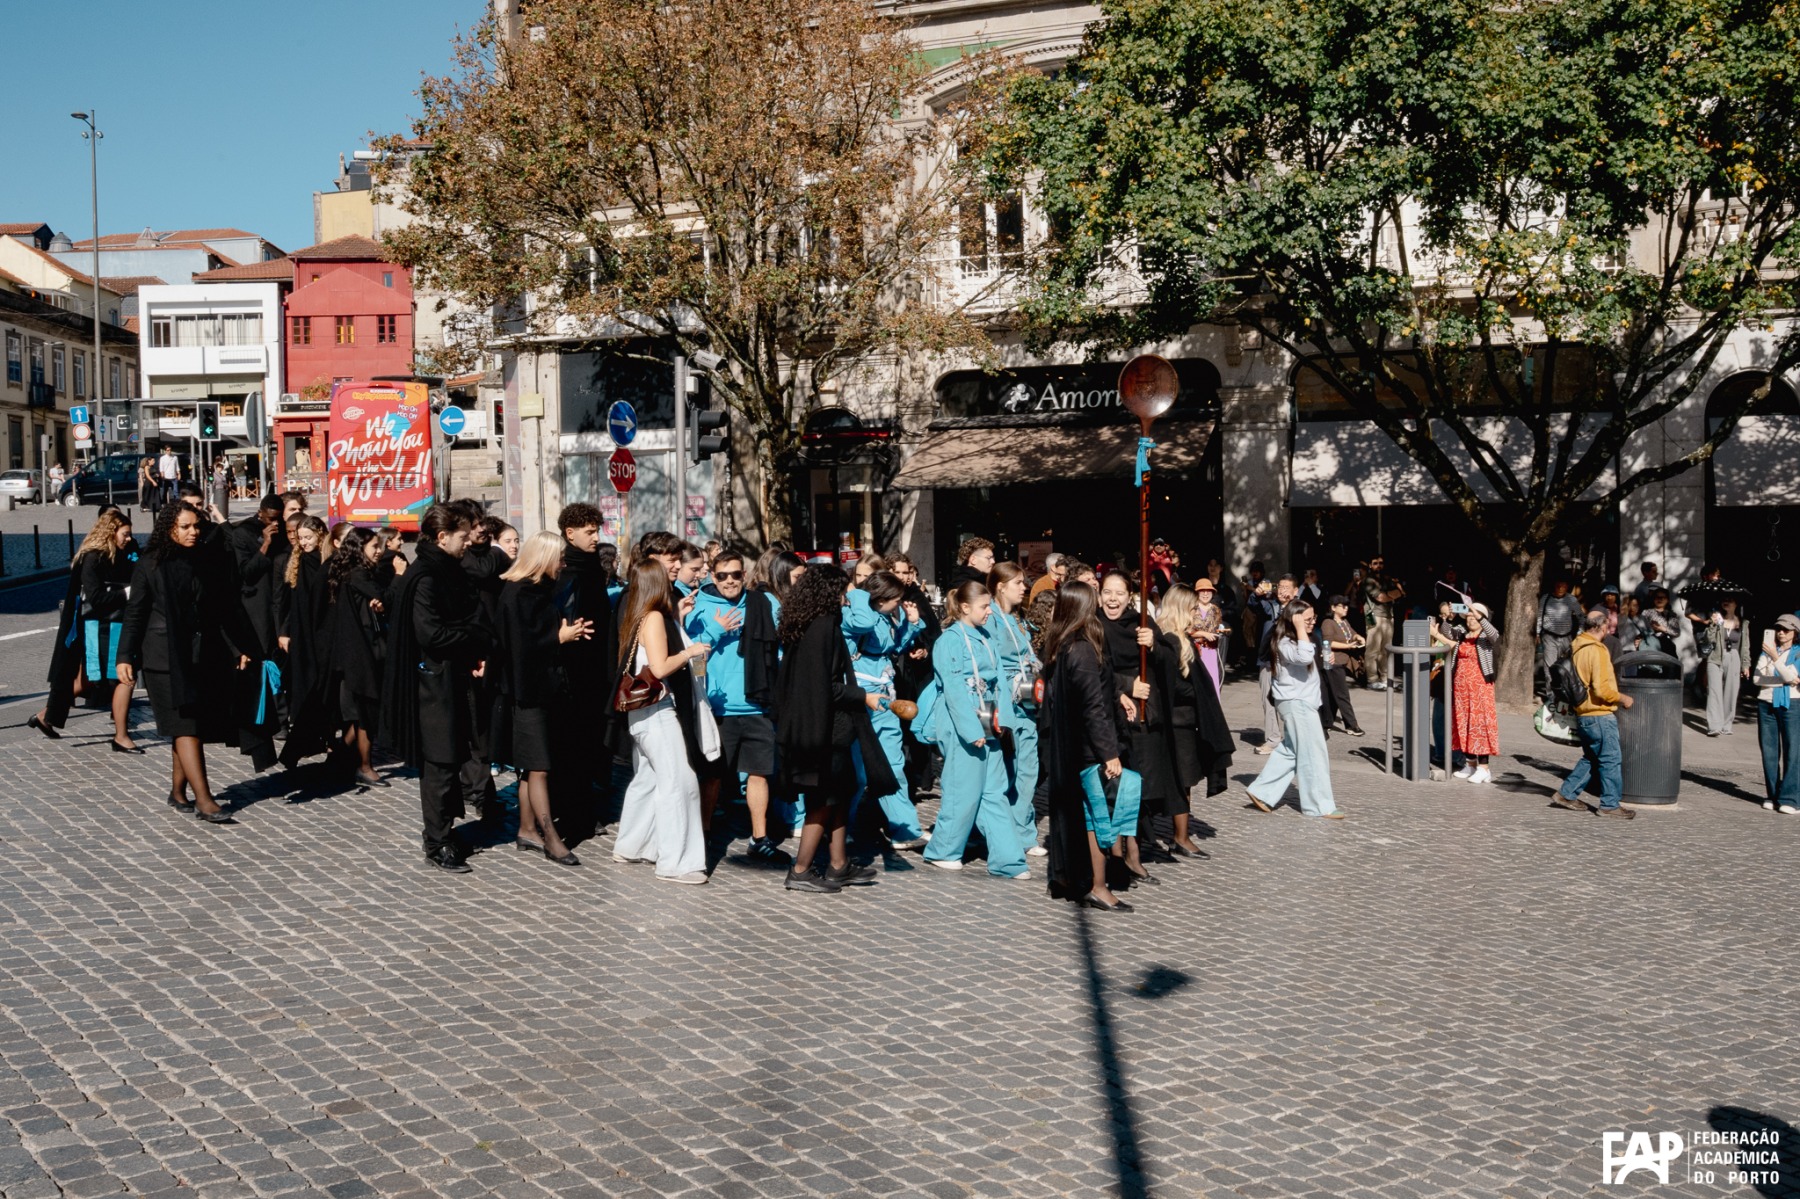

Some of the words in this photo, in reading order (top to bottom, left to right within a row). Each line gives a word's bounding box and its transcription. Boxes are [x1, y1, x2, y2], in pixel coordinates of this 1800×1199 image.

[1035, 382, 1123, 410] Amori
[366, 411, 396, 438] We
[330, 437, 389, 470] Show
[380, 429, 424, 471] You
[330, 448, 432, 506] World!
[362, 461, 380, 476] the
[611, 462, 636, 478] STOP
